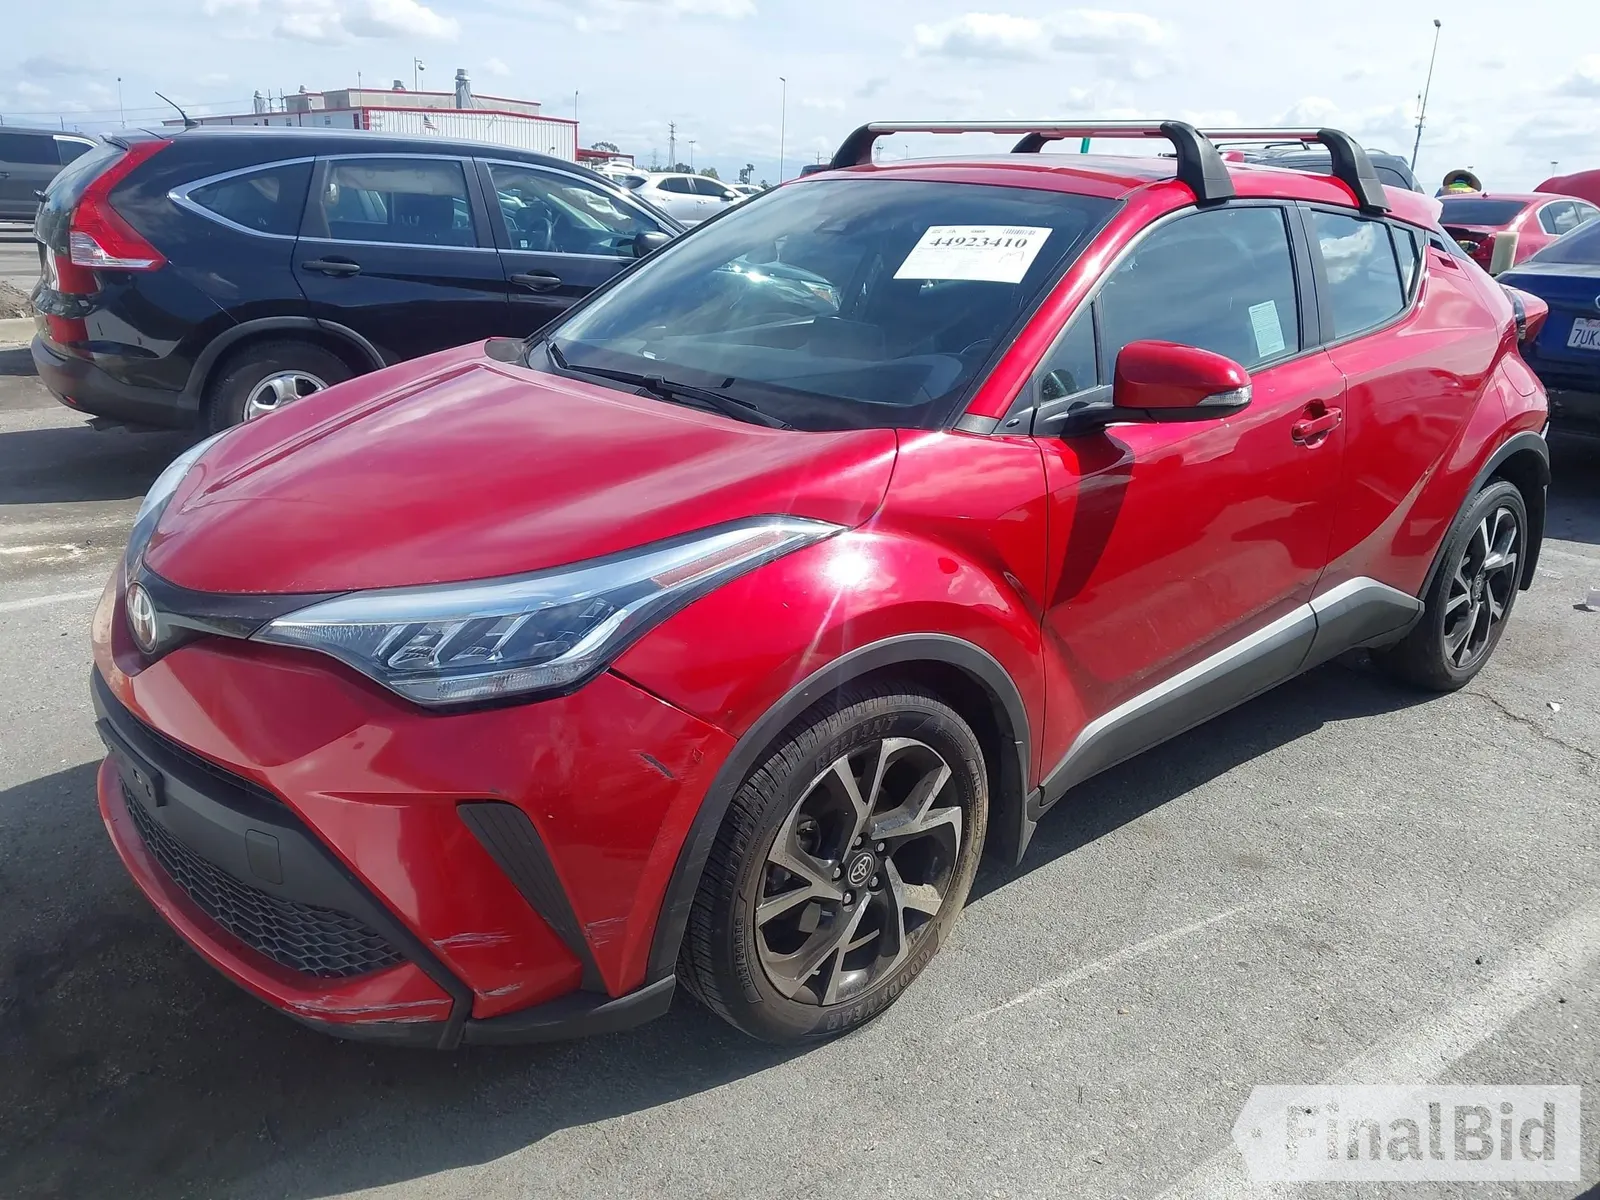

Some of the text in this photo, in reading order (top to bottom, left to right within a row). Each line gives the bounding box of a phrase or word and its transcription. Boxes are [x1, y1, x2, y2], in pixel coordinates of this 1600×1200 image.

[929, 236, 1028, 249] 44923410
[1573, 328, 1600, 346] 7UK
[826, 949, 931, 1031] GOODYEAR
